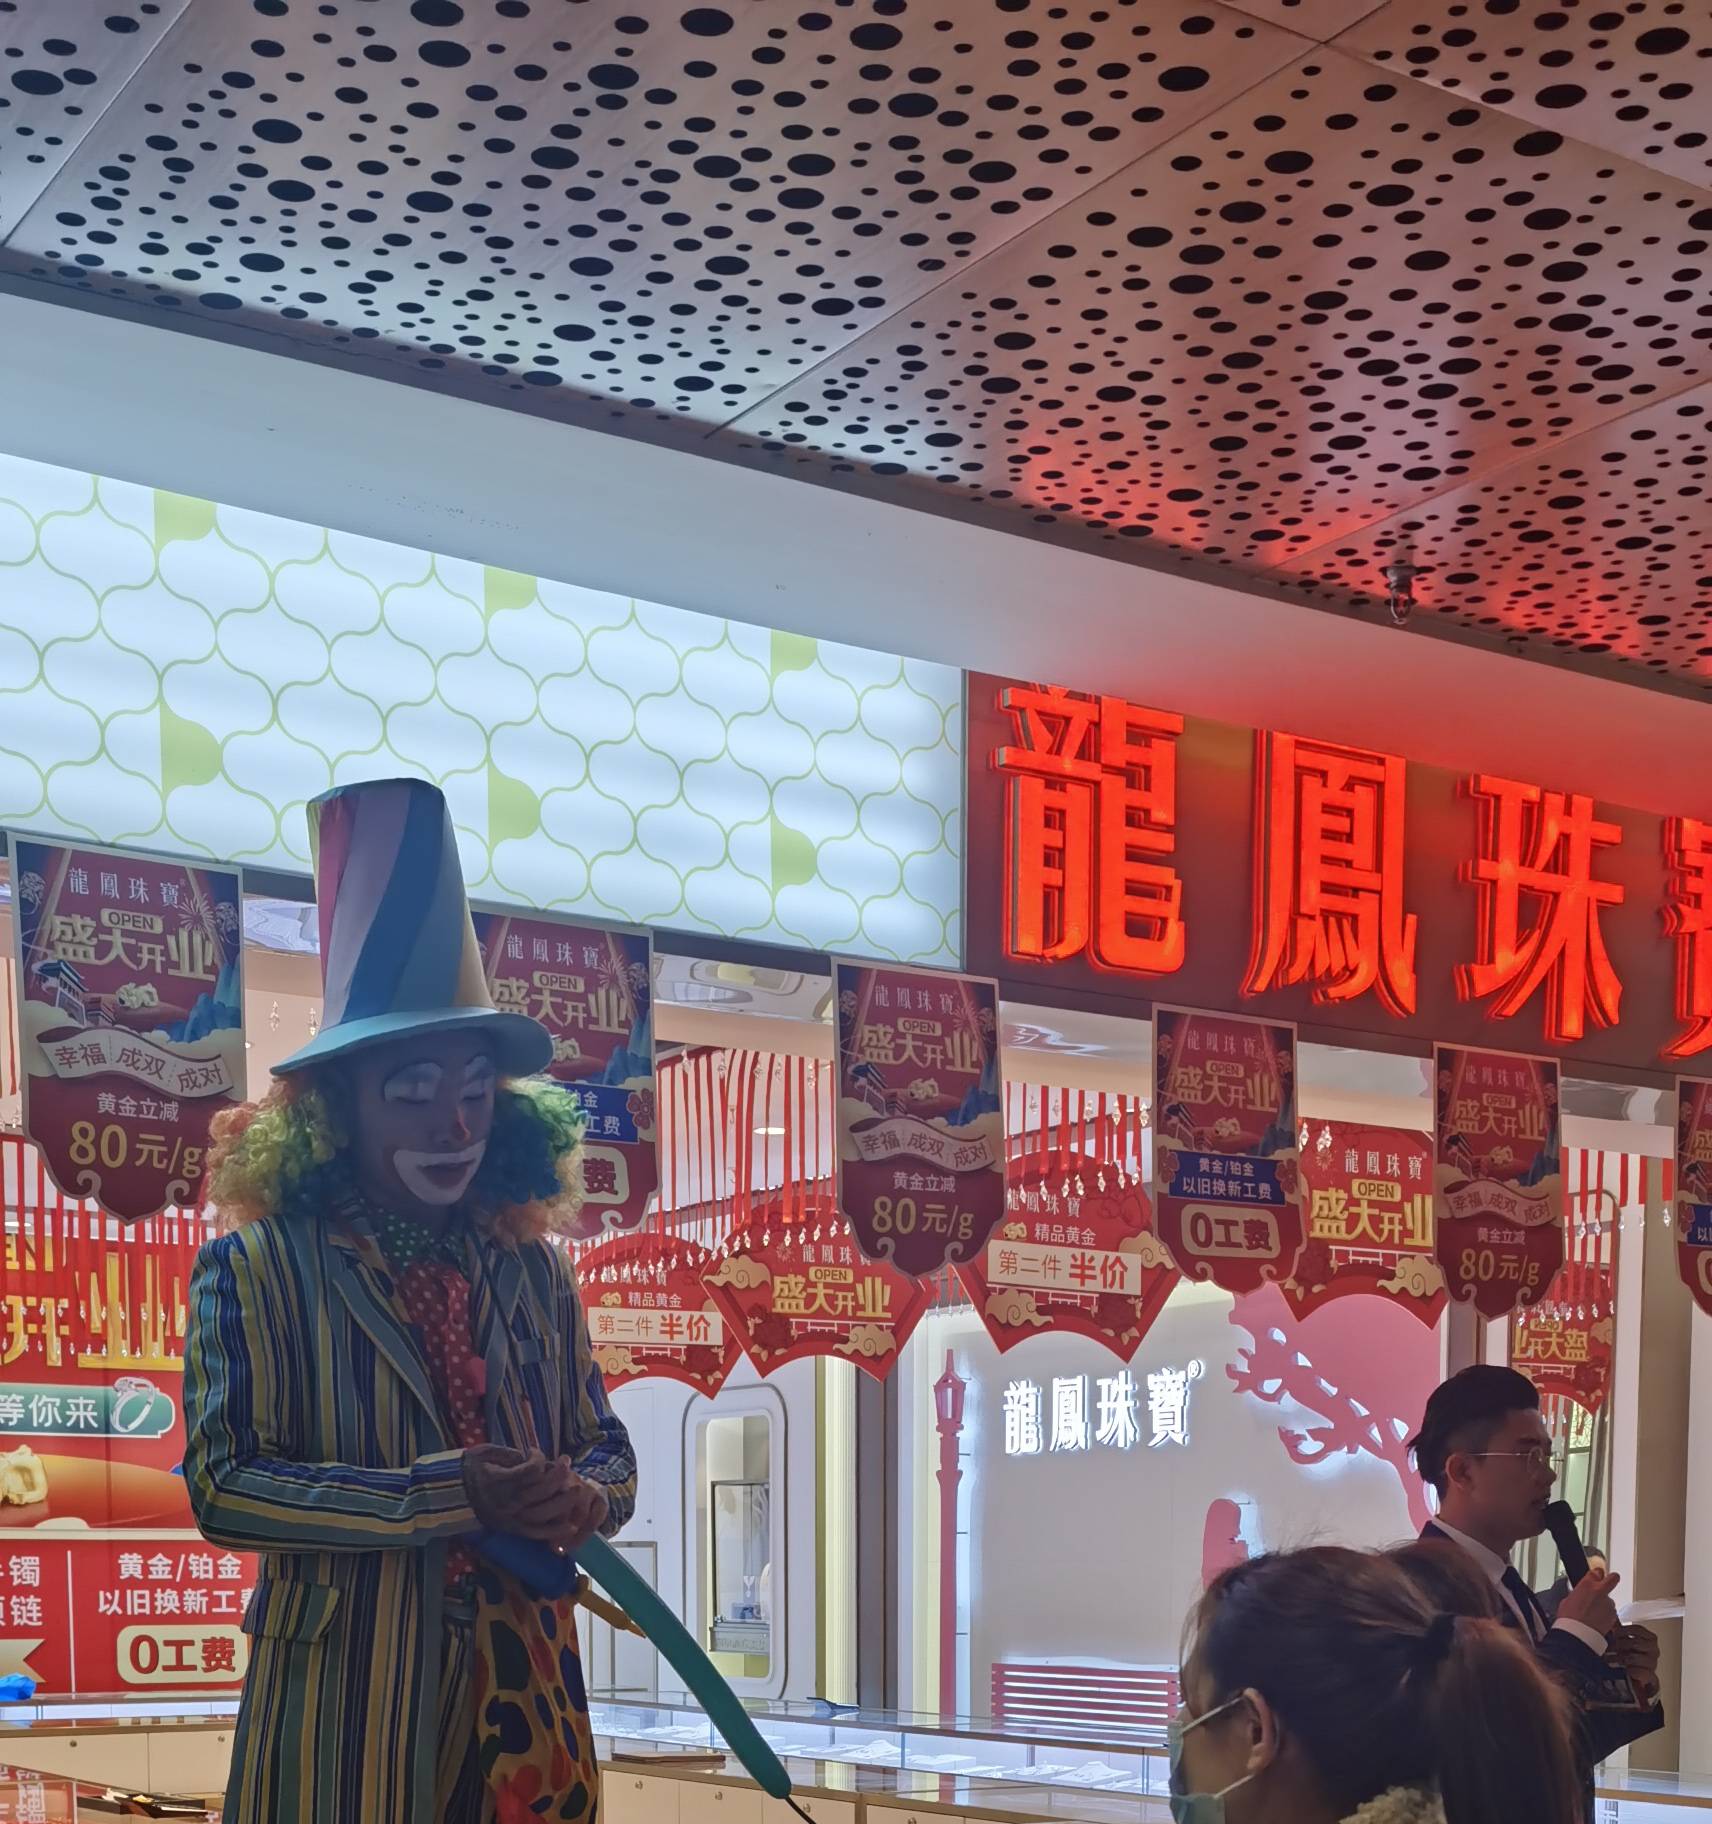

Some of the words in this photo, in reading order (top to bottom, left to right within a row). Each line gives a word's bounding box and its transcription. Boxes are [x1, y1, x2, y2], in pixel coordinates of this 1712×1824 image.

[67, 866, 180, 908] 龍鳳珠寶
[108, 911, 154, 931] OPEN
[52, 914, 216, 982] 盛大开业
[506, 934, 600, 970] 龍鳳珠寶
[539, 973, 577, 991] OPEN
[874, 985, 953, 1016] 龍鳳珠寶
[902, 1019, 936, 1034] OPEN
[860, 1022, 980, 1074] 盛大开业
[54, 1043, 107, 1068] 幸福
[115, 1045, 166, 1081] 成双
[176, 1063, 224, 1093] 成对
[1210, 1063, 1240, 1076] OPEN
[1174, 1064, 1278, 1113] 盛大开业
[96, 1091, 180, 1123] 黄金立减
[1453, 1098, 1546, 1142] 盛大开业
[861, 1131, 900, 1152] 幸福
[1198, 1158, 1255, 1177] 黄金/铂金
[1344, 1148, 1423, 1180] 龍鳳珠寶
[893, 1170, 955, 1194] 黄金立减
[1182, 1176, 1273, 1201] 以旧换新工费
[1357, 1181, 1395, 1198] OPEN
[1190, 1211, 1273, 1252] 0工费
[1309, 1187, 1433, 1248] 盛大开业
[1034, 1222, 1097, 1247] 精品黄金
[1477, 1226, 1526, 1246] 黄金立减
[813, 1269, 848, 1282] OPEN
[998, 1249, 1063, 1282] 第二件
[1068, 1251, 1129, 1291] 半价
[628, 1291, 682, 1308] 精品黄金
[772, 1273, 893, 1319] 盛大开业
[597, 1314, 654, 1336] 第二件
[659, 1315, 711, 1343] 半价
[0, 1392, 98, 1429] 等你来
[0, 1555, 40, 1588] 镯
[118, 1552, 243, 1582] 黄金/铂金
[0, 1595, 43, 1628] 链
[129, 1634, 236, 1675] 0工费
